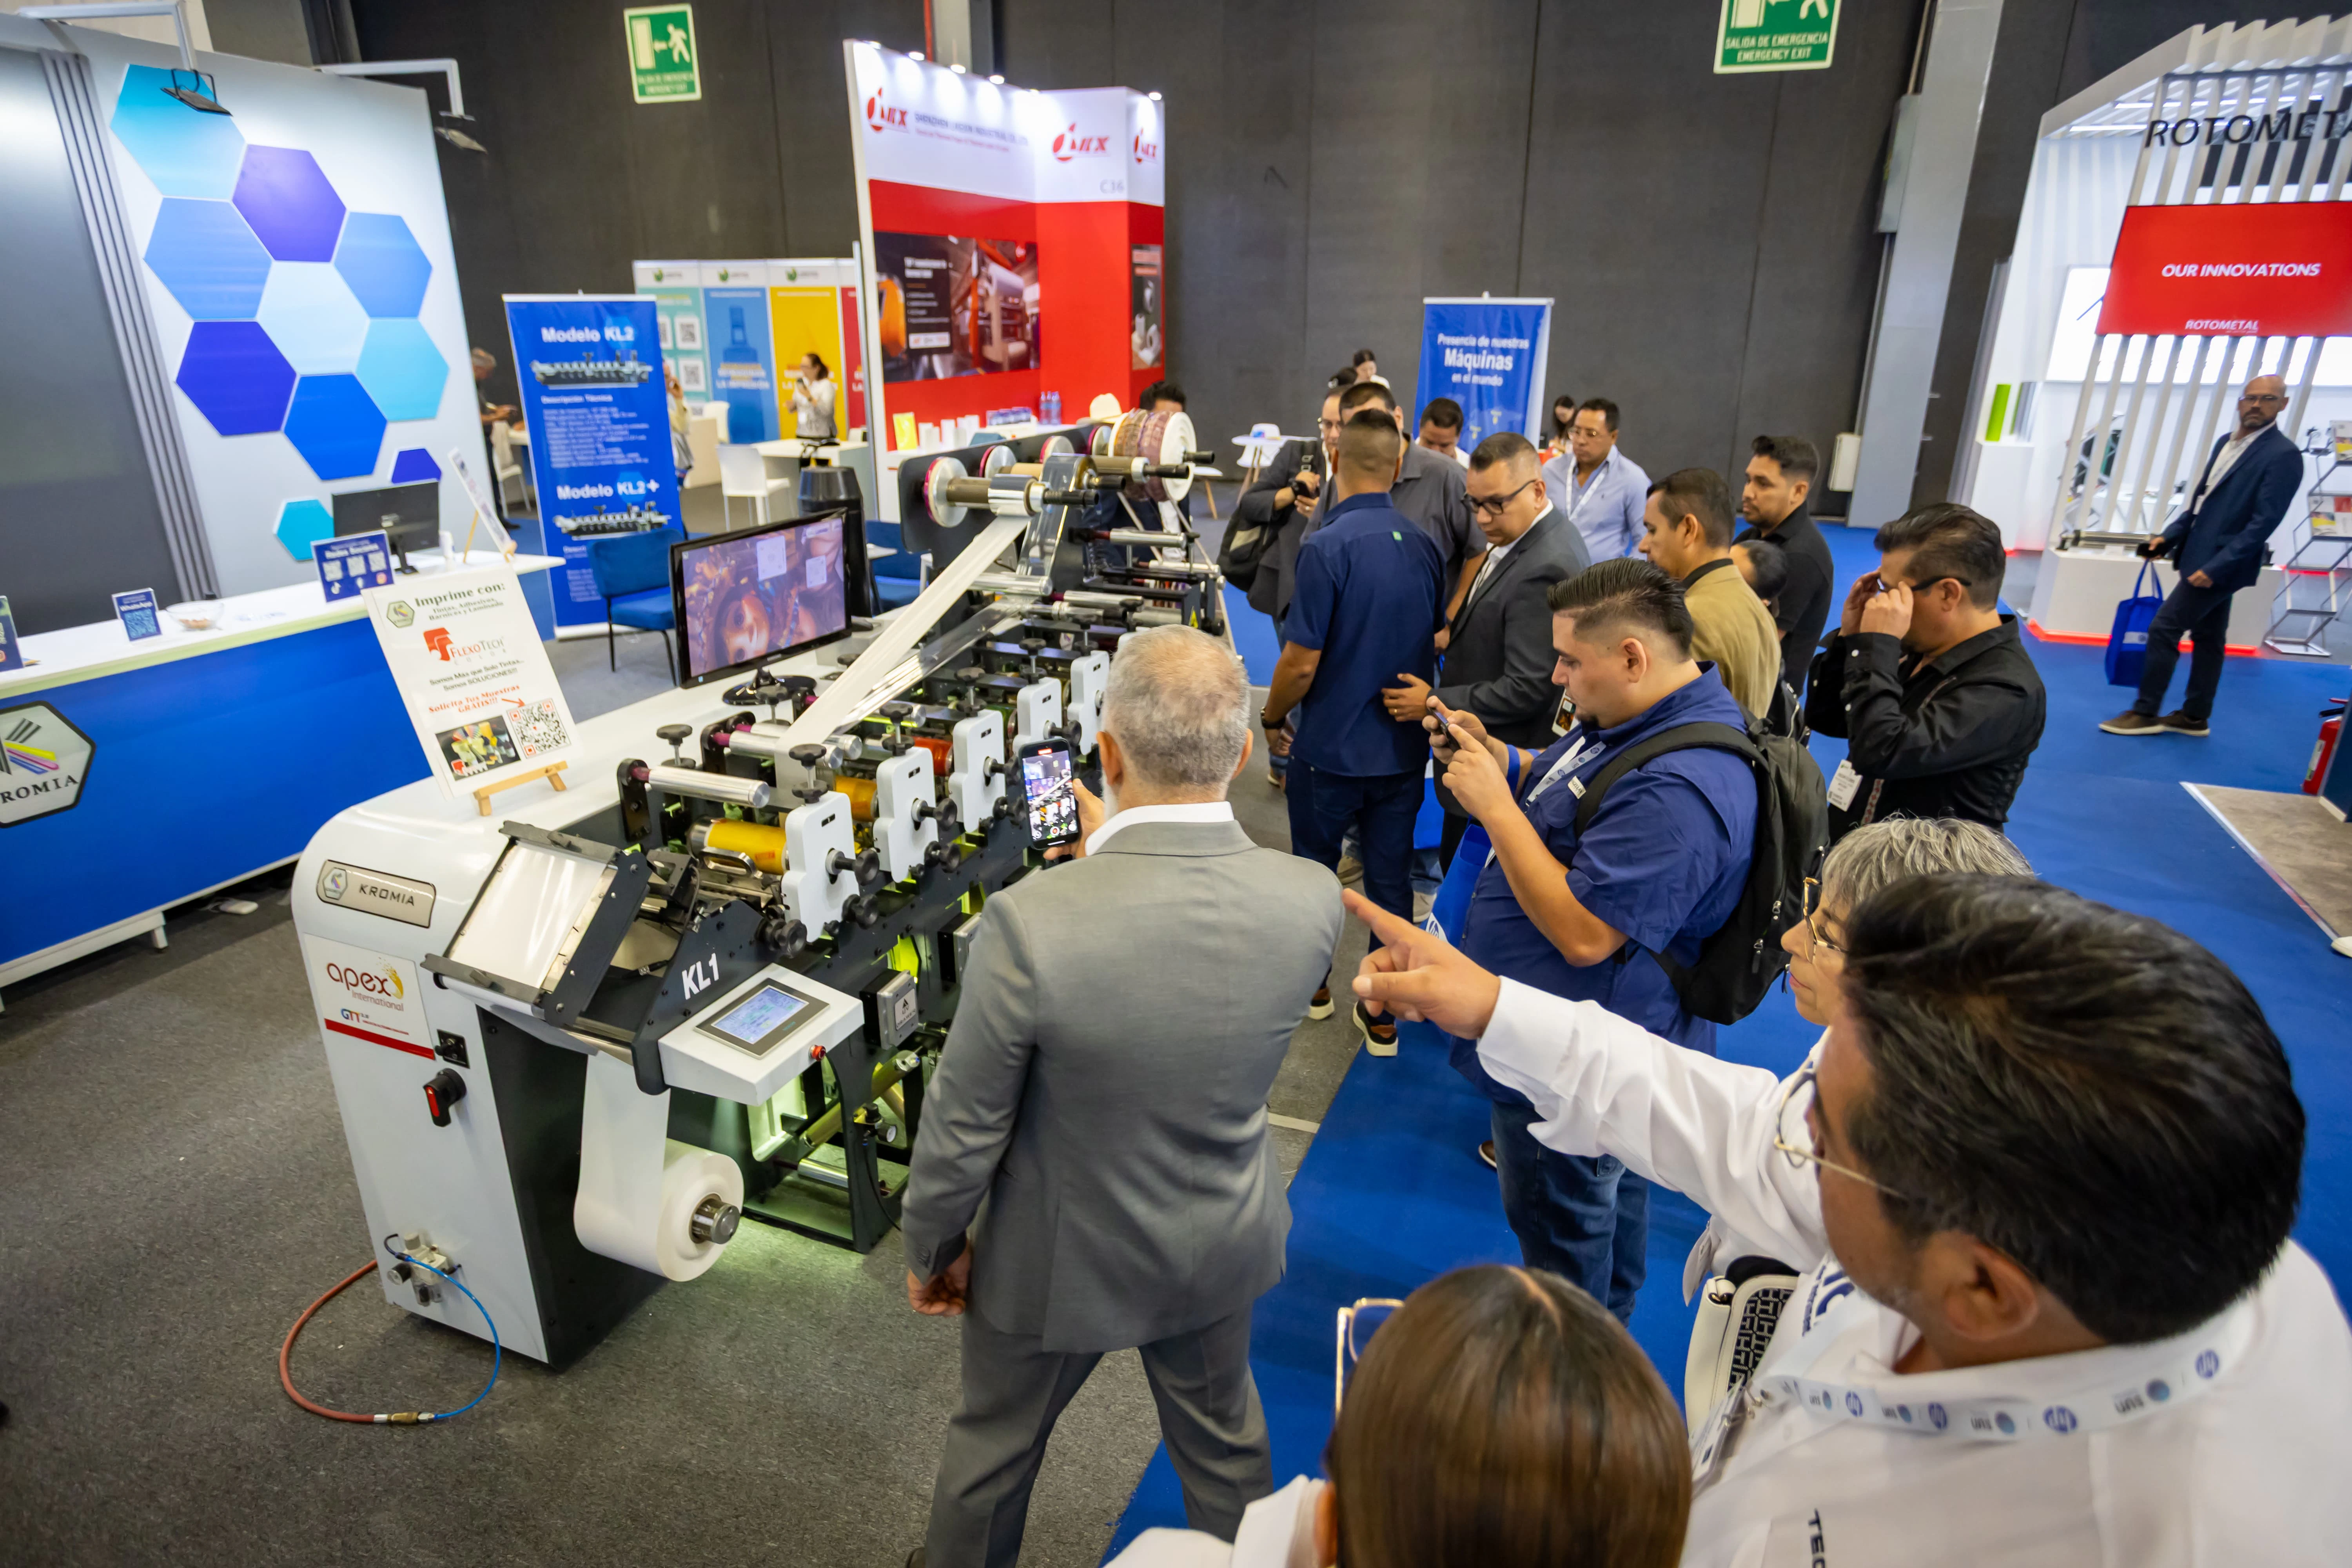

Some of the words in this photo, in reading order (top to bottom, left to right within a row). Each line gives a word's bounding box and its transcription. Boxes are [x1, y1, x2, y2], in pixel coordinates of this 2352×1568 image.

[1724, 36, 1756, 49] SALIDA
[1757, 34, 1771, 47] DE
[1771, 31, 1829, 47] EMERGENCIA
[1737, 48, 1791, 63] EMERGENCY
[1791, 46, 1813, 59] EXIT
[2161, 264, 2198, 277] OUR
[2200, 263, 2321, 277] INNOVATIONS
[2184, 319, 2259, 330] ROTOMETAL
[541, 326, 601, 343] Modelo
[603, 326, 635, 341] KL2
[1437, 332, 1477, 347] Presencia
[1477, 335, 1490, 348] de
[1491, 337, 1529, 350] nuestras
[1444, 347, 1514, 372] Máquinas
[1451, 373, 1462, 383] en
[1472, 375, 1504, 387] mundo
[556, 483, 614, 500] Modelo
[414, 589, 474, 607] Imprime
[477, 583, 506, 595] con:
[428, 699, 463, 713] Solicita
[481, 684, 521, 699] Muestras
[359, 884, 414, 906] KROMIA
[327, 963, 391, 997] apex
[682, 953, 719, 1000] KL1
[352, 990, 404, 1012] International
